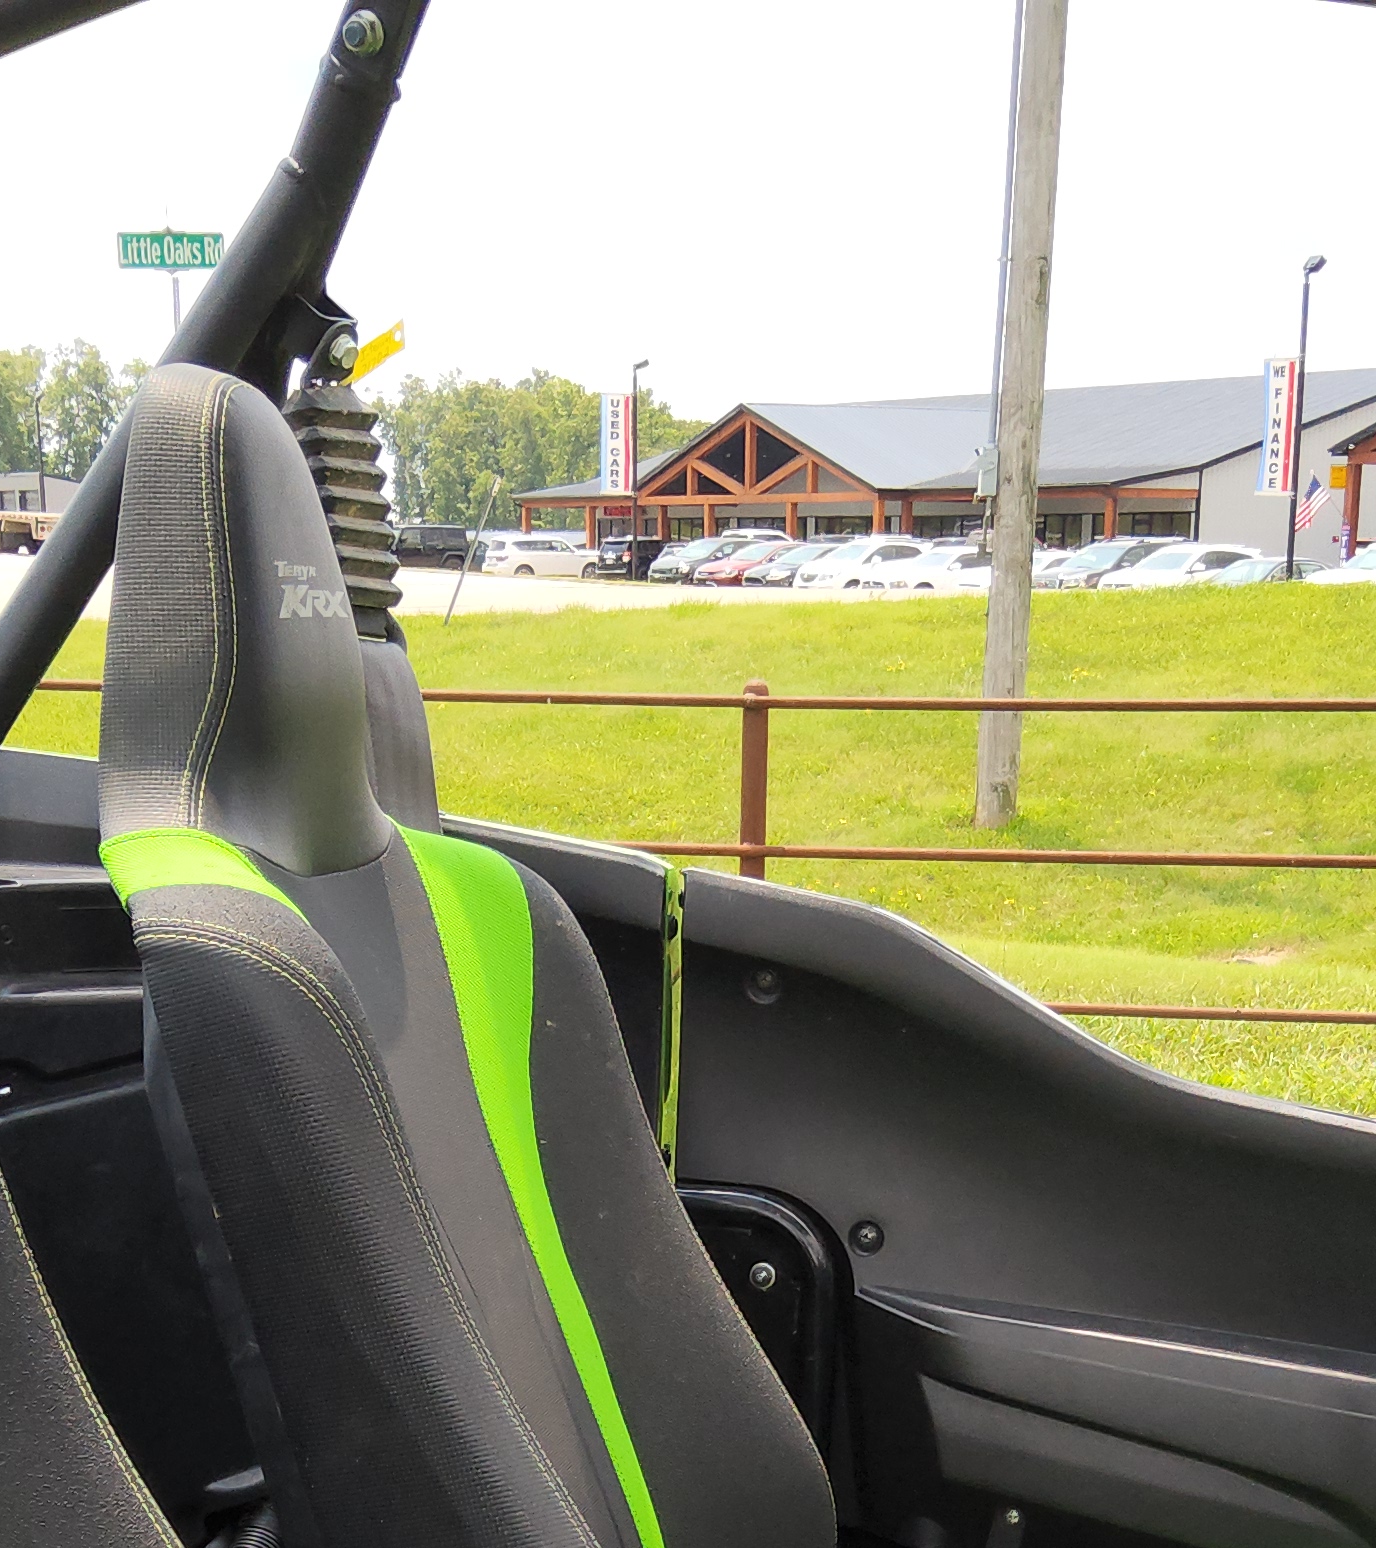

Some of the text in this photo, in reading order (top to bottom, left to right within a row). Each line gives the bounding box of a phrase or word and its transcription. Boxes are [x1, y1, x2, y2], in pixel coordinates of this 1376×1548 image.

[119, 236, 222, 265] Little Oaks Rd
[1273, 366, 1286, 378] WE
[610, 399, 620, 440] USED
[1268, 388, 1282, 488] FINANCE
[610, 448, 620, 489] CARS
[279, 584, 349, 619] KRX
